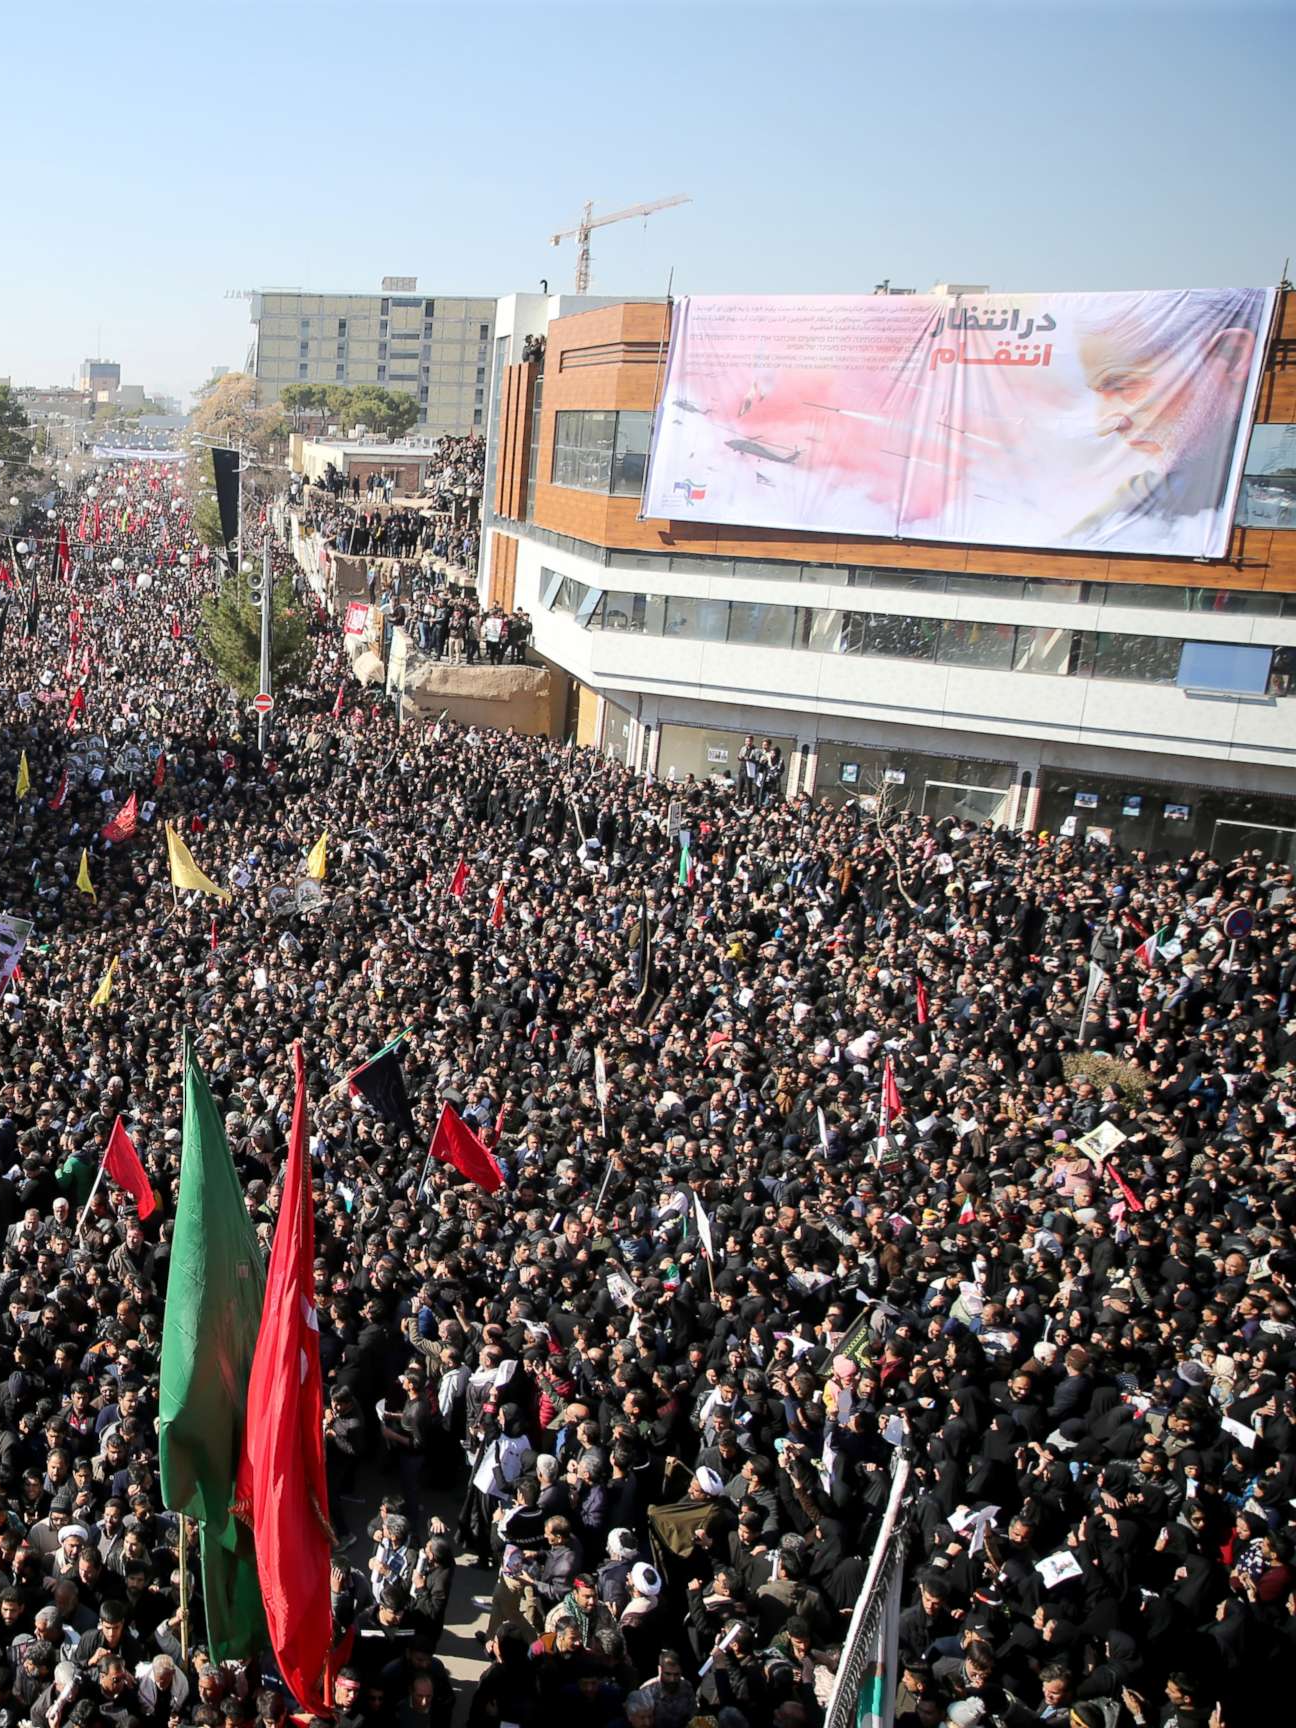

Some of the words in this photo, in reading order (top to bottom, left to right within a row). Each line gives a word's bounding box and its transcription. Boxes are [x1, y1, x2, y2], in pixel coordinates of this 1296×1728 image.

[930, 306, 1020, 338] انتظار
[1017, 313, 1057, 339] در
[929, 341, 1053, 371] انتقام
